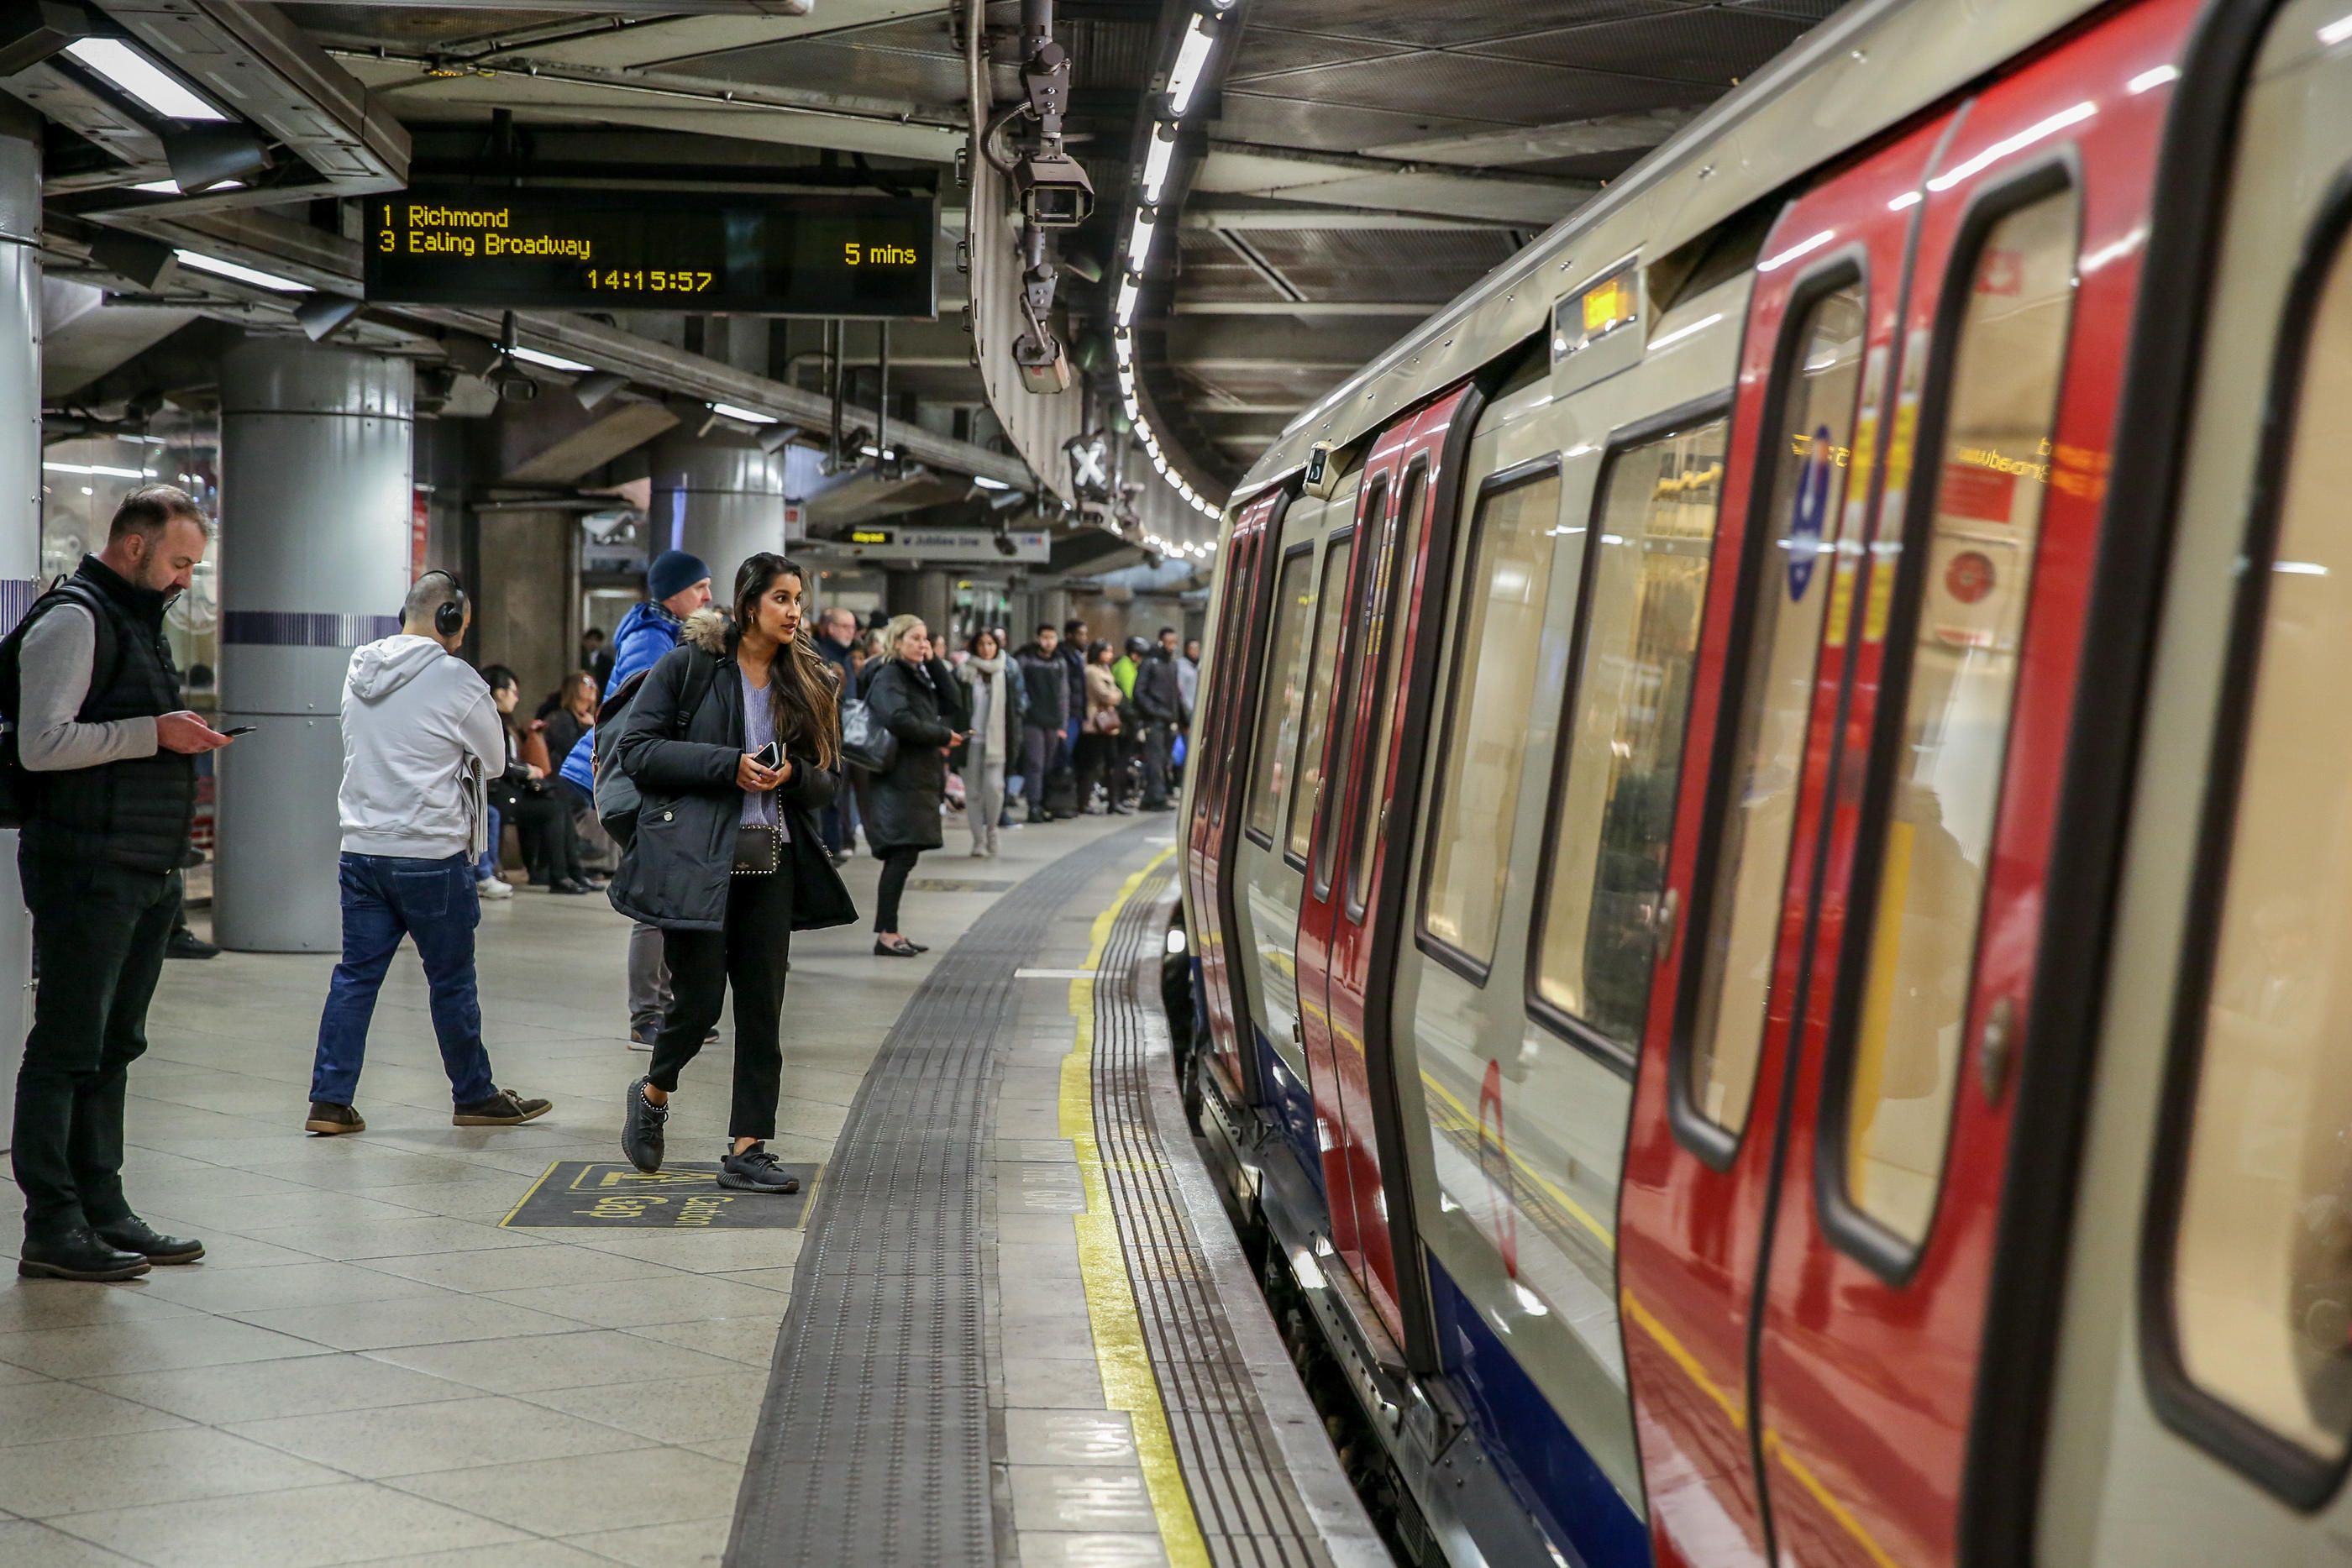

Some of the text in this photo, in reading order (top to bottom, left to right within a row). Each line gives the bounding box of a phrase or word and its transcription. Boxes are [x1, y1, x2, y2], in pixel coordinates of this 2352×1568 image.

[382, 203, 509, 228] 1 Richmond
[379, 228, 917, 265] 3 Ealing Broadway 5 mins
[587, 269, 712, 292] 14:15:57
[572, 1195, 669, 1219] Gap
[674, 1196, 735, 1226] Caution
